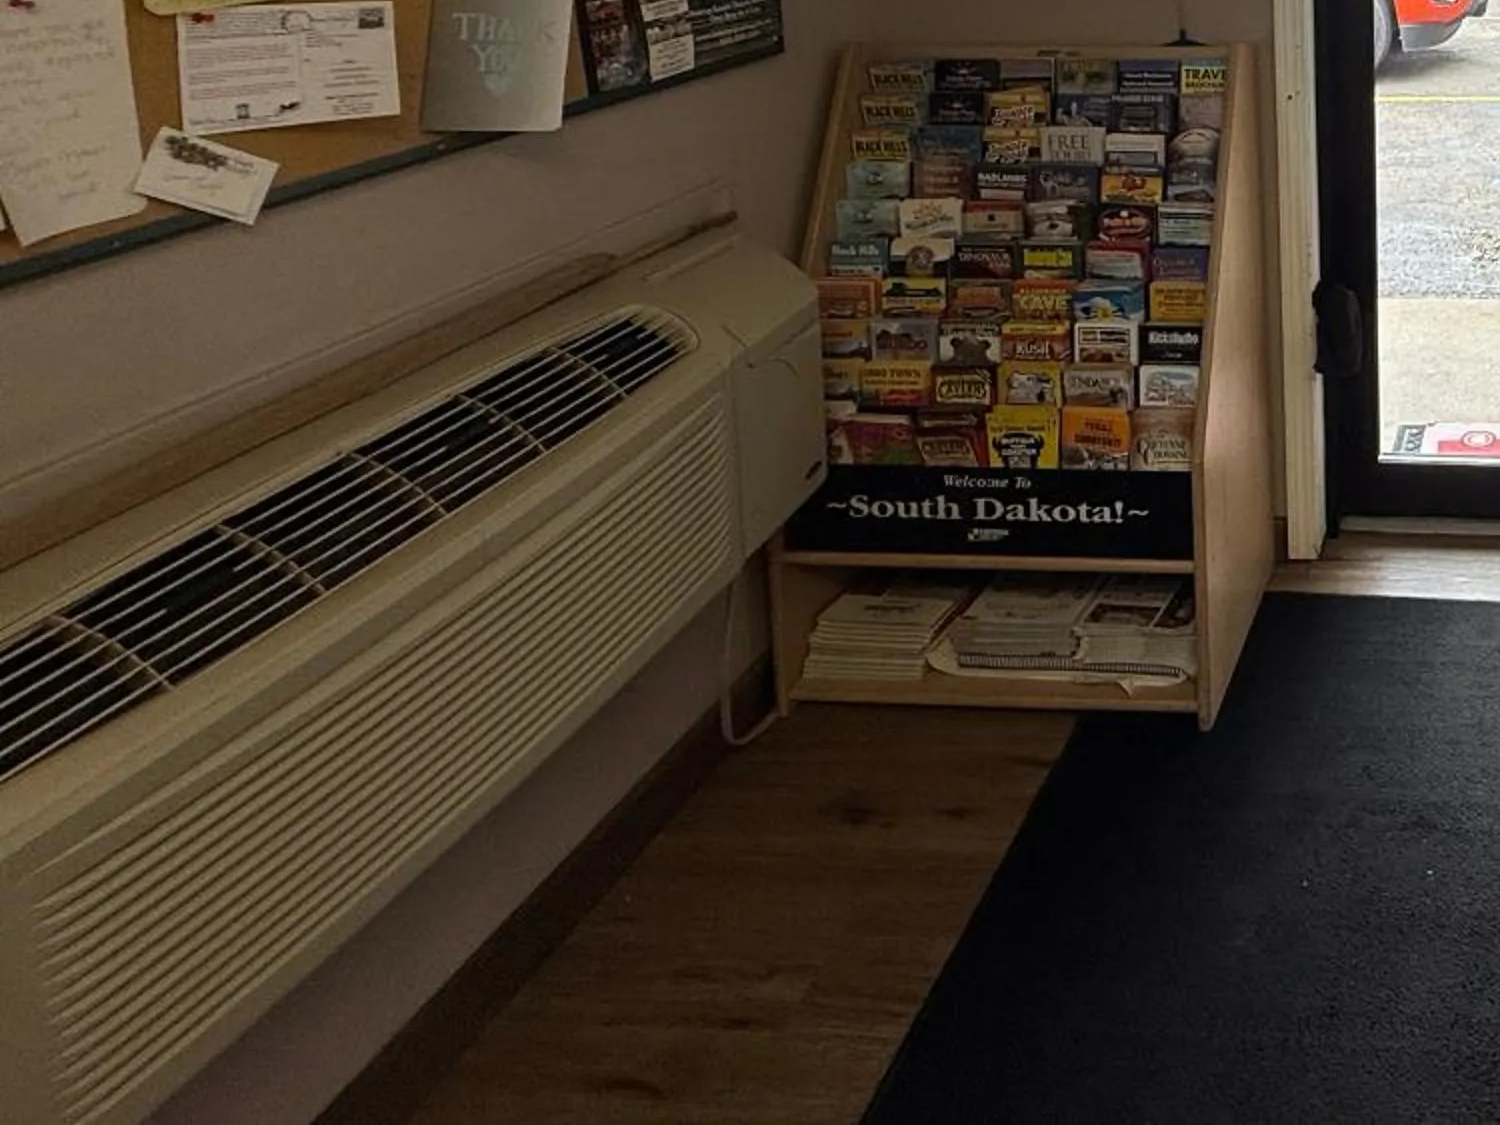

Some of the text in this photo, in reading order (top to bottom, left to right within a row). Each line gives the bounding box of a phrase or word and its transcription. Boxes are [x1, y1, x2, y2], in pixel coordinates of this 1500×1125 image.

[1018, 295, 1069, 312] CAVE
[943, 474, 1033, 489] Welcome To
